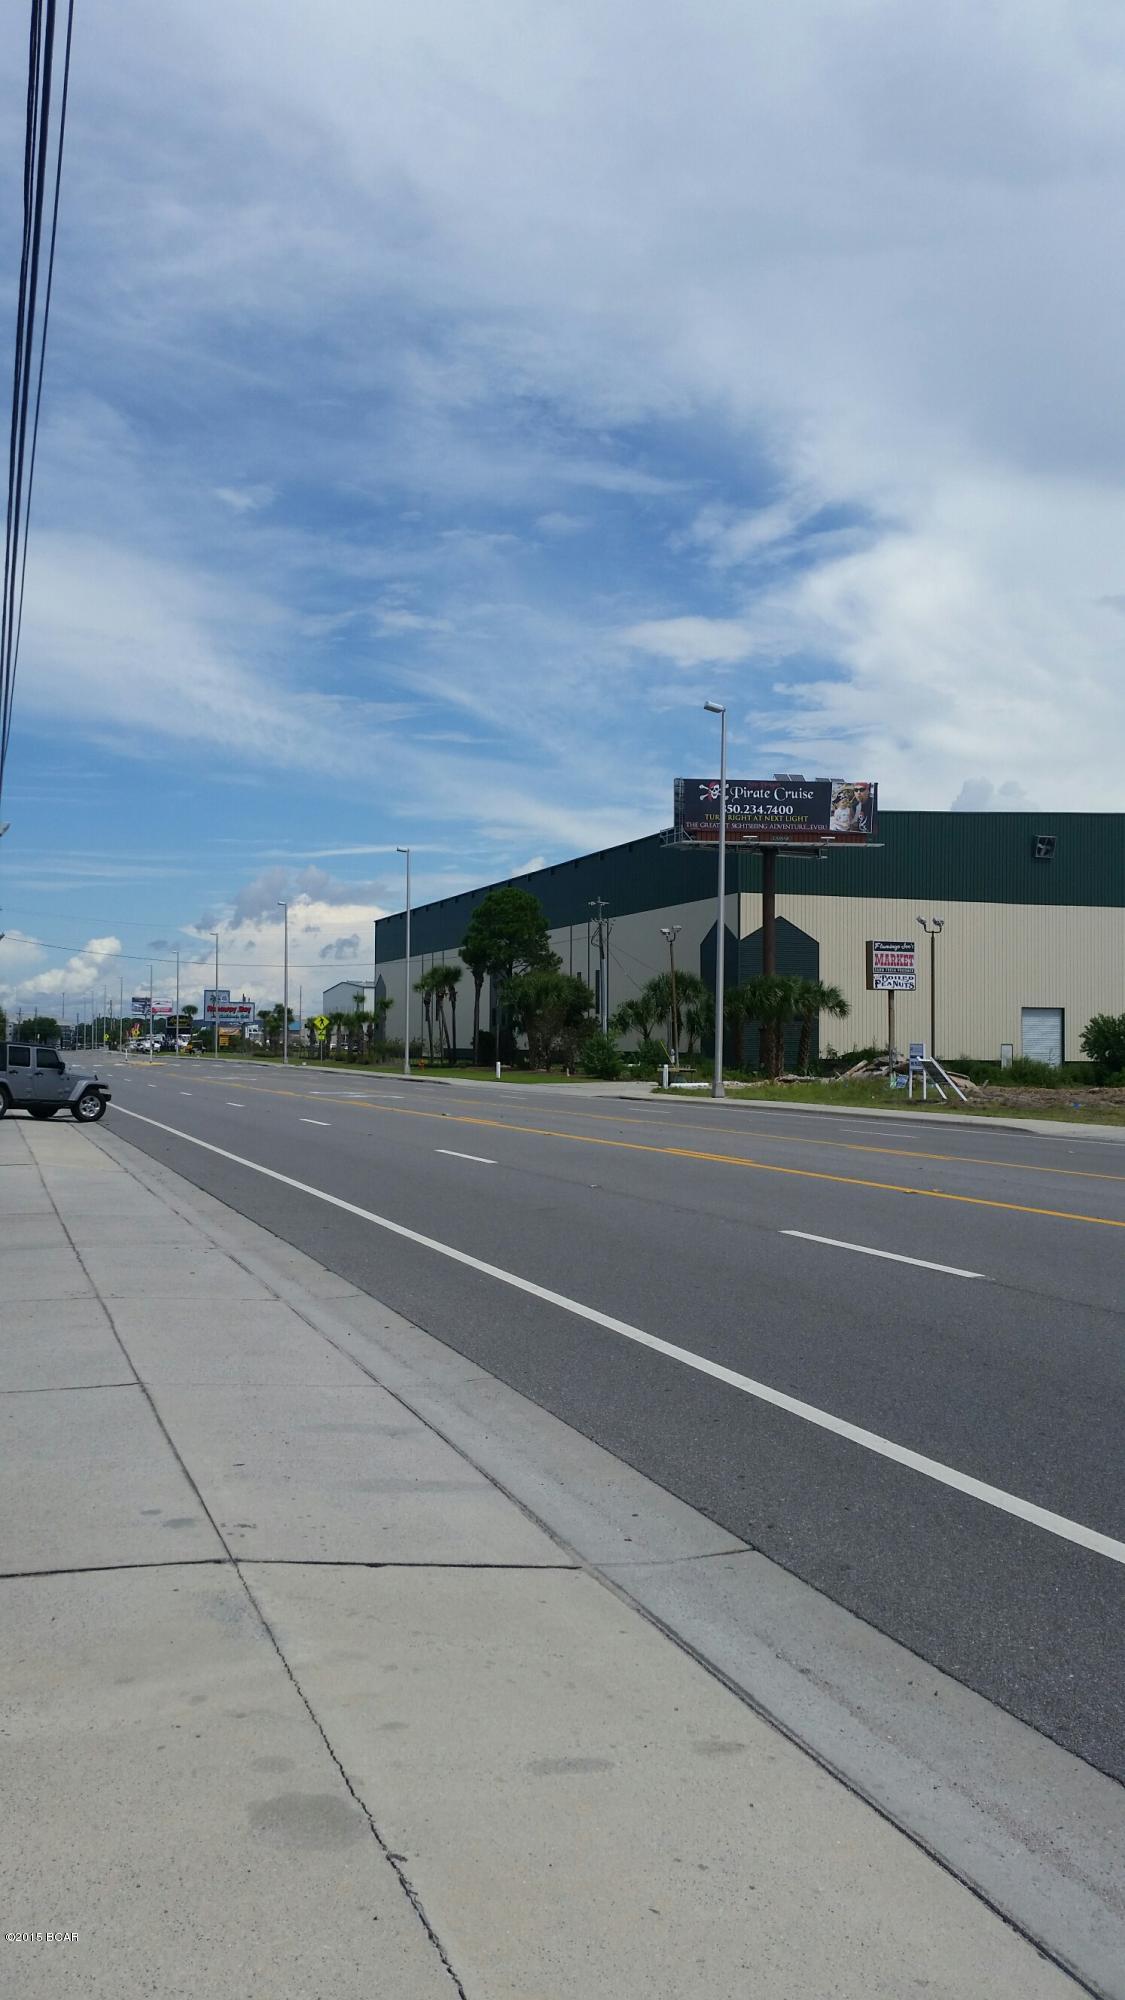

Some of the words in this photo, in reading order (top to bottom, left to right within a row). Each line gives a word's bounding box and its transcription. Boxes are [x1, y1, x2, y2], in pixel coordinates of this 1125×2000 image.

[730, 786, 770, 802] Pirate
[773, 787, 814, 801] Cruise
[704, 813, 721, 821] TUR
[727, 814, 751, 822] RIGHT
[785, 815, 808, 823] LIGHT
[874, 953, 915, 967] MARKET
